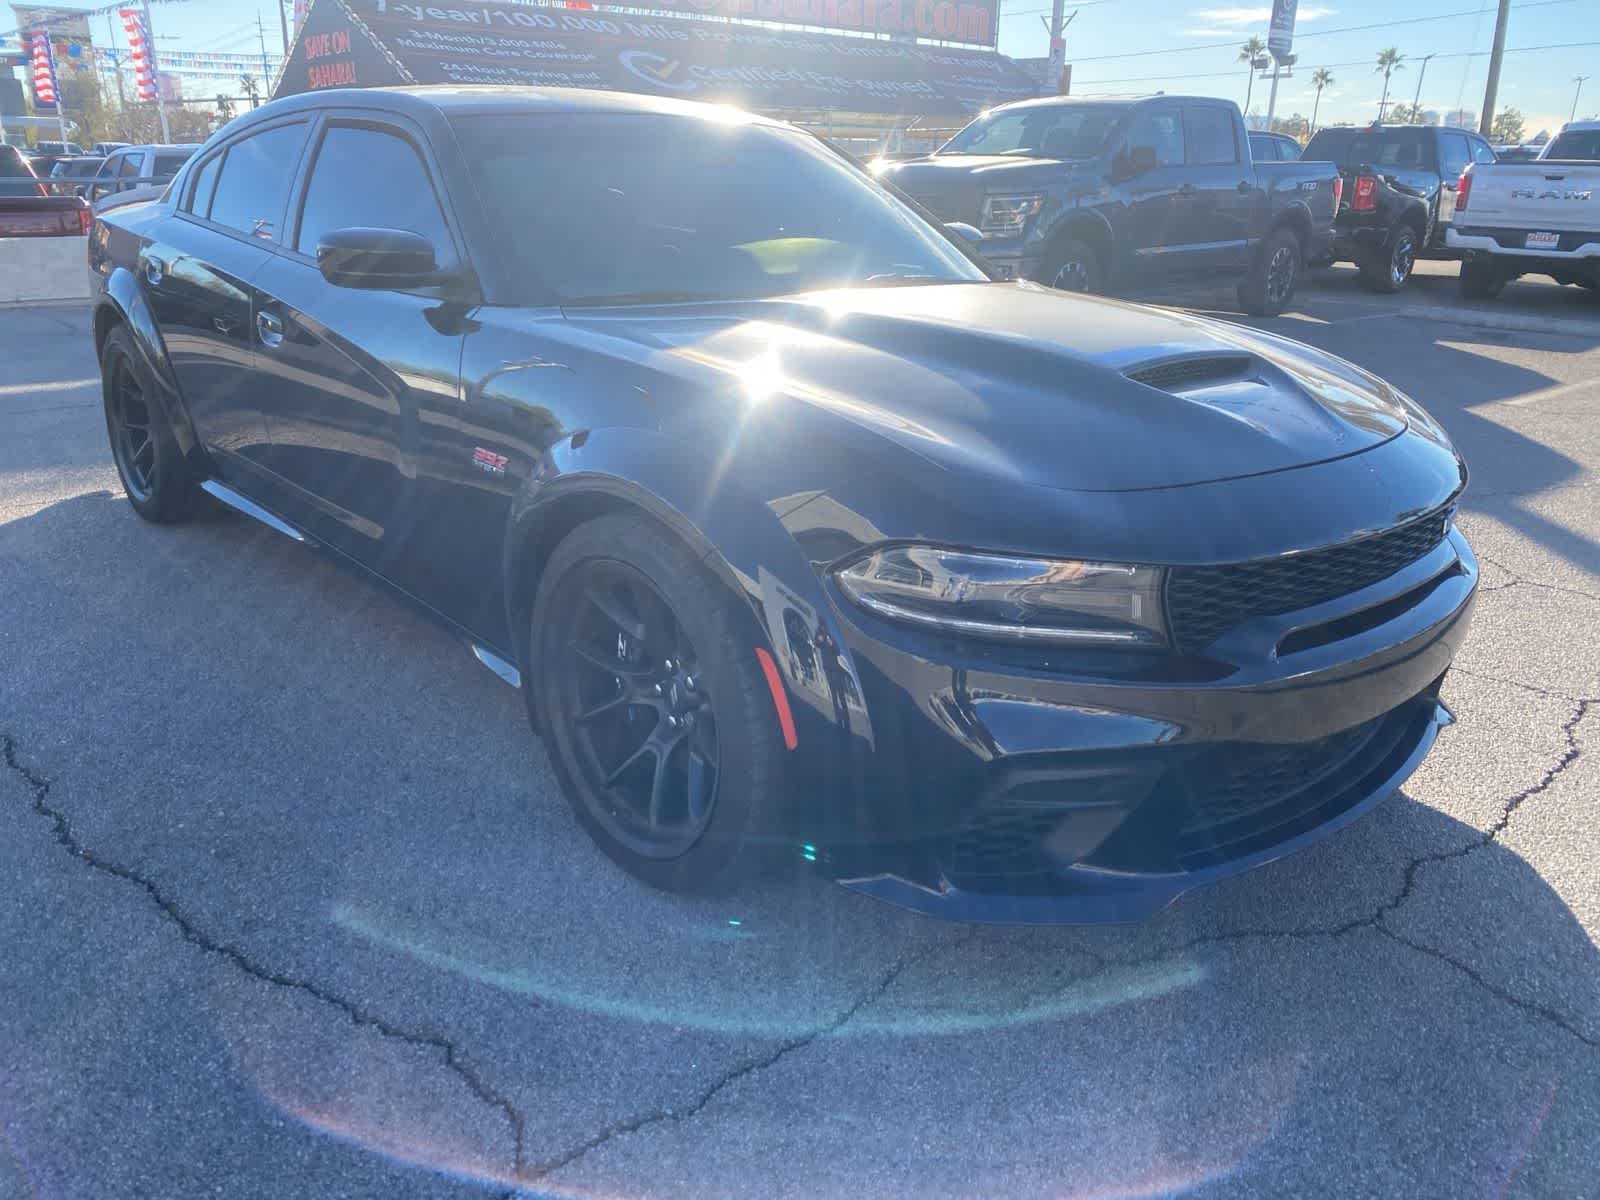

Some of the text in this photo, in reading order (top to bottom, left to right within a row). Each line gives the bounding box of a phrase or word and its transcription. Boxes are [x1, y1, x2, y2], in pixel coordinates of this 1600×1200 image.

[623, 22, 689, 41] Mile
[304, 28, 352, 60] SAVE ON
[397, 37, 481, 55] Maximum
[1511, 189, 1592, 201] RAM
